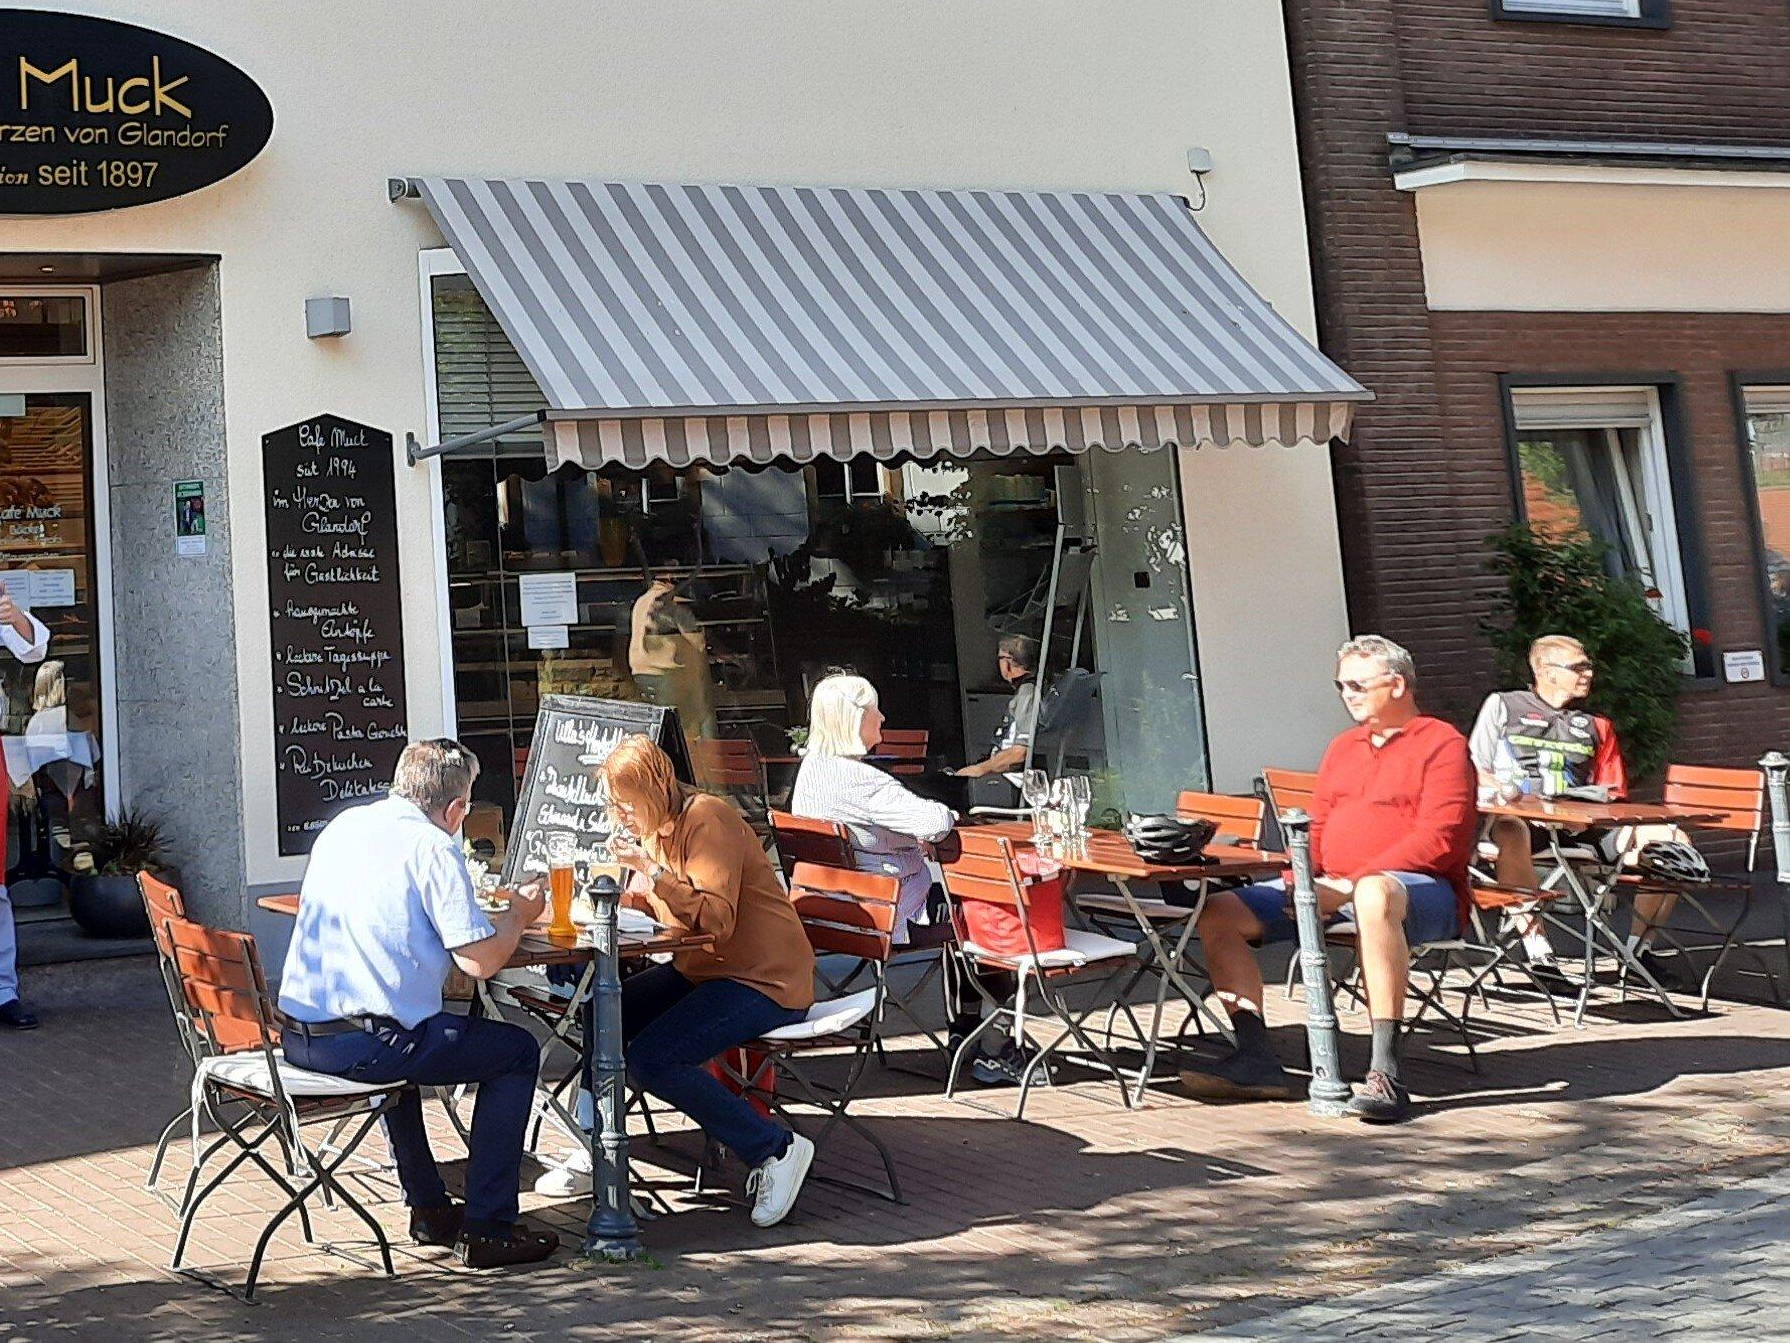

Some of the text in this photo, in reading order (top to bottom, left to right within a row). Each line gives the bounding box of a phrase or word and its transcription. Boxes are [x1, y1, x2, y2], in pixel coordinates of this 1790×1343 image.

[19, 56, 192, 119] Muck
[64, 126, 108, 145] von
[118, 121, 229, 148] Glandorf
[38, 159, 89, 186] seit
[96, 160, 159, 188] 1897
[331, 427, 369, 448] Muck
[326, 457, 357, 479] 1994
[26, 503, 62, 519] Muck
[293, 486, 340, 512] Herzen
[344, 496, 366, 508] von
[302, 511, 371, 545] Glandorf
